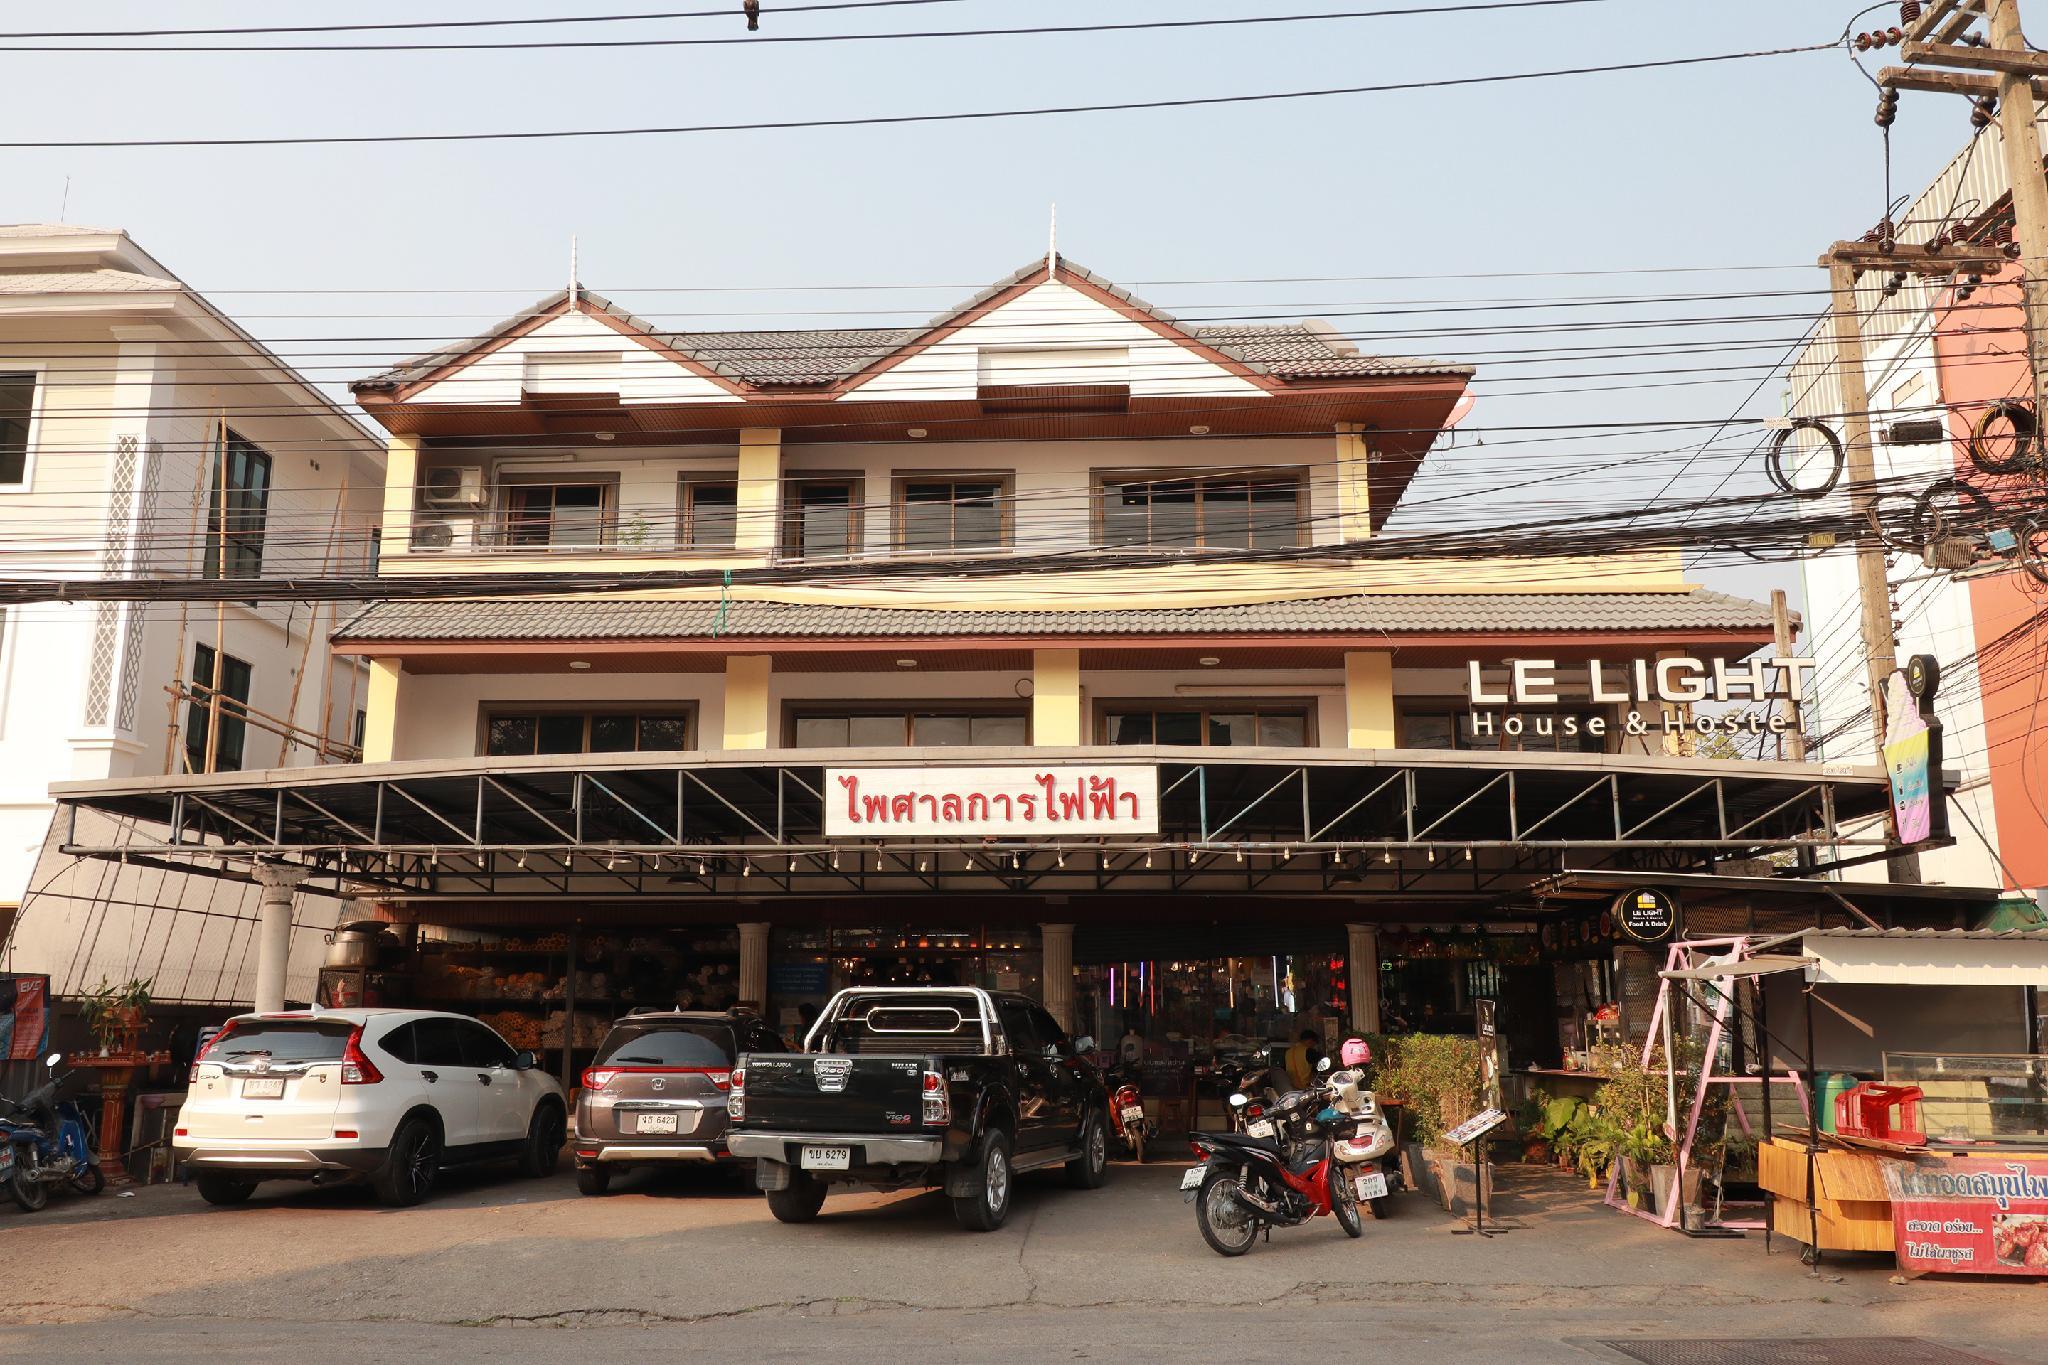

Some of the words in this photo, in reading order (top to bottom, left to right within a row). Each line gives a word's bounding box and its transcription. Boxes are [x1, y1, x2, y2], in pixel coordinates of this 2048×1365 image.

[1469, 659, 1557, 703] LE
[1589, 657, 1816, 703] LIGHT
[1473, 711, 1606, 736] House
[1626, 711, 1649, 736] &
[1664, 709, 1807, 736] Hostel
[838, 773, 1141, 823] ไพศาลการไฟฟ้า
[656, 1116, 676, 1124] 6423
[825, 1149, 847, 1160] 6279
[1906, 1219, 1941, 1233] สะอาด
[1943, 1217, 1984, 1234] อร่อย...
